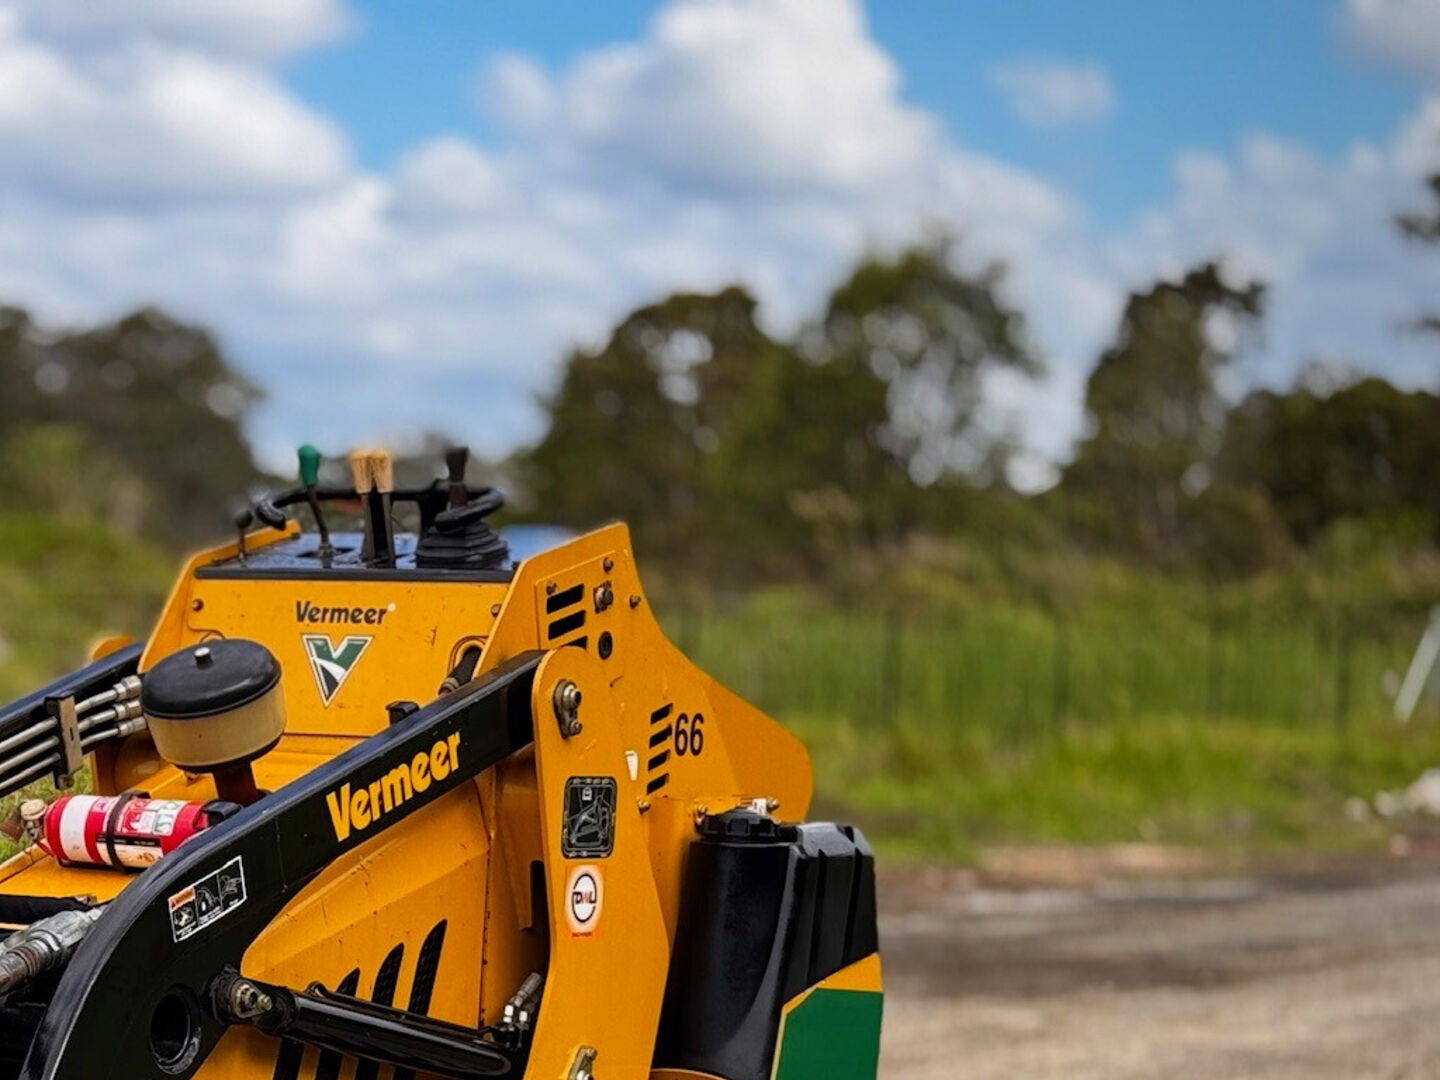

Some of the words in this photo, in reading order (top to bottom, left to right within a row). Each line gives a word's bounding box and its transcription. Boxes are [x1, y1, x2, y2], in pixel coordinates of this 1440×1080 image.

[296, 600, 387, 624] Vermeer
[675, 712, 704, 757] 66
[326, 731, 461, 842] Vermeer
